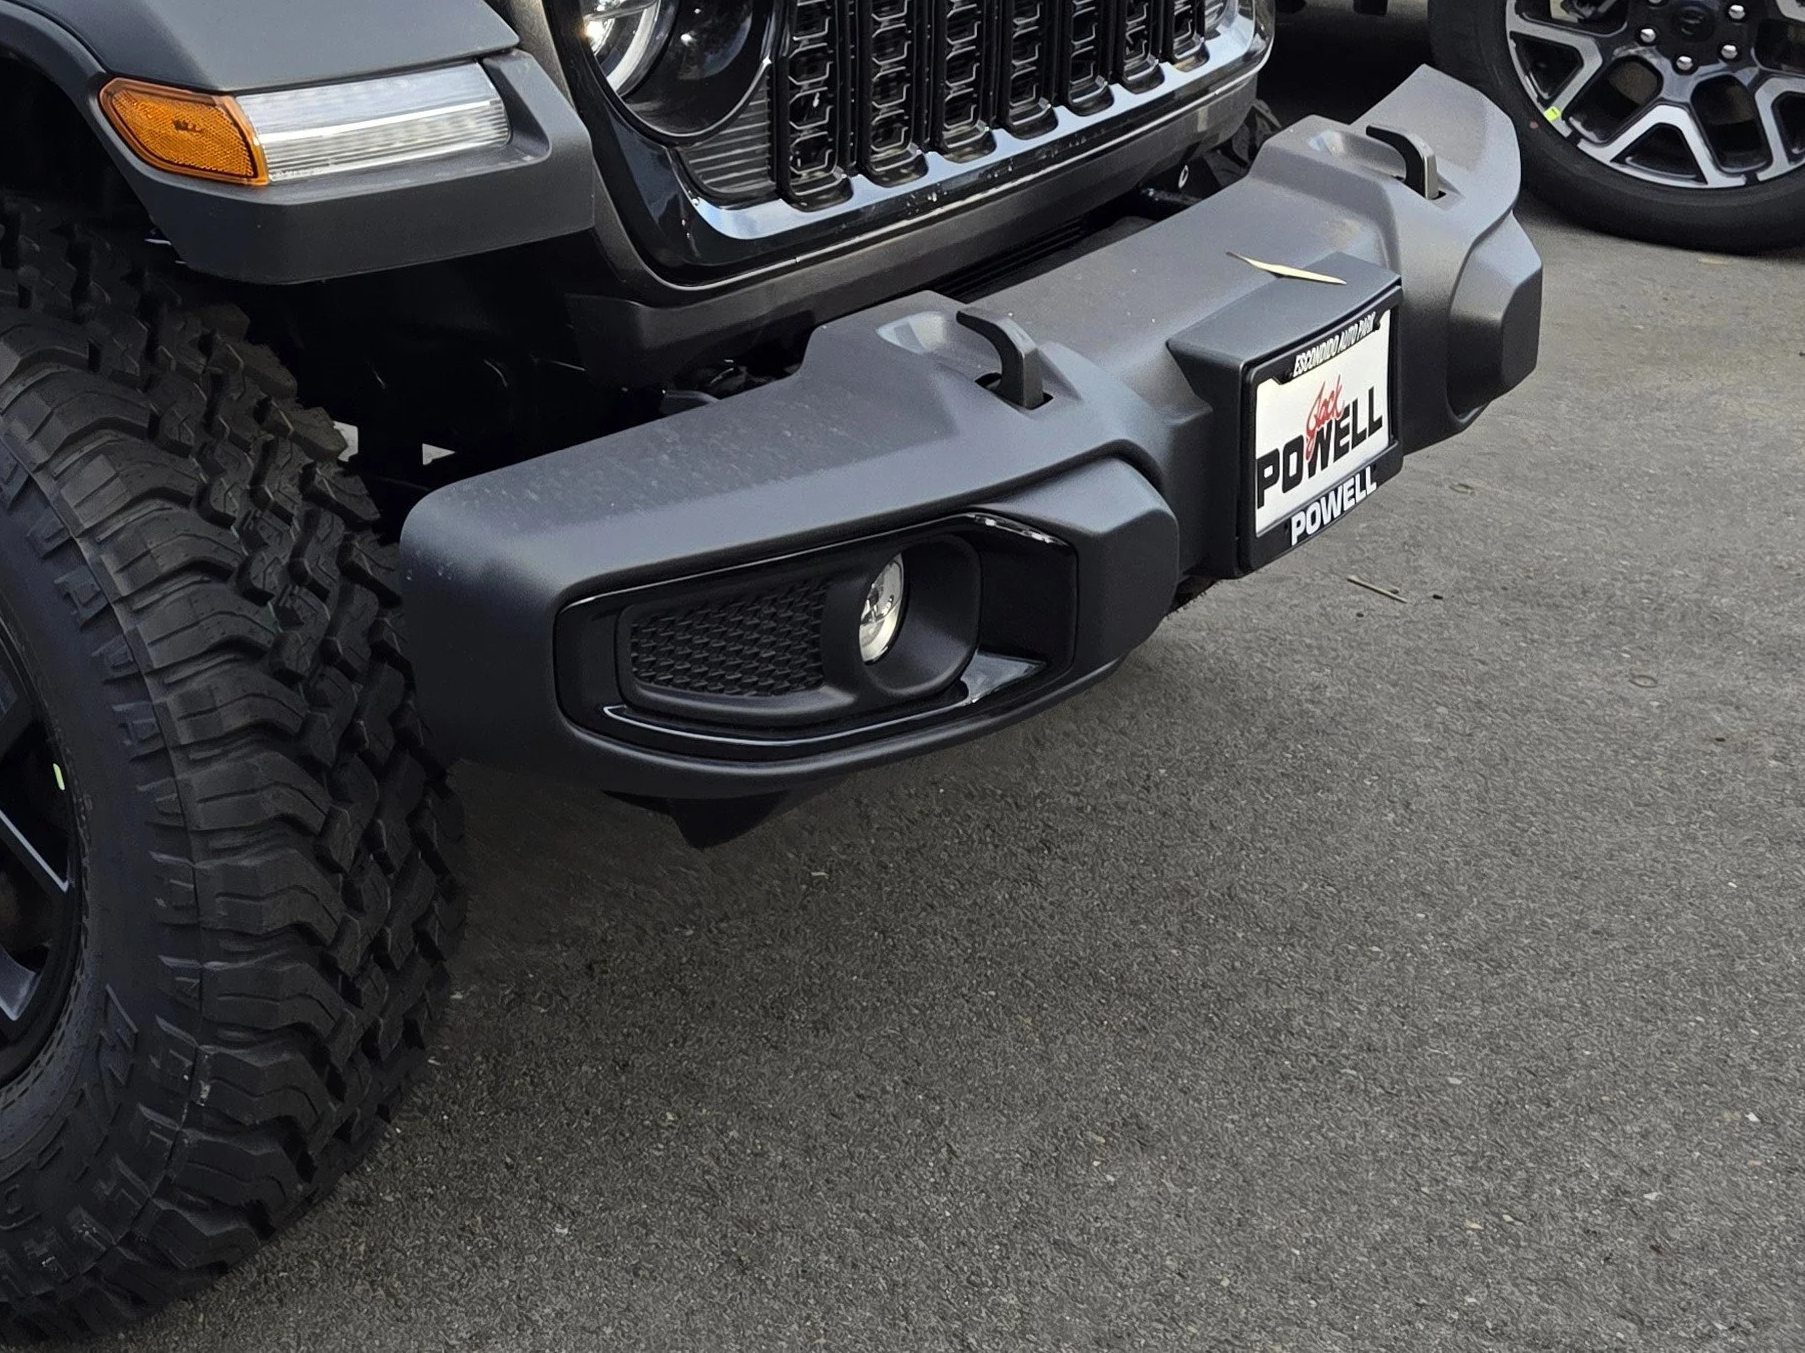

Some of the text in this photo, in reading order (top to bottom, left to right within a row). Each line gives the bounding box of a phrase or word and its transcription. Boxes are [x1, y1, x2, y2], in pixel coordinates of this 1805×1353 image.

[1293, 333, 1340, 378] ESCONDIDO
[1257, 386, 1383, 509] POWELL
[1306, 374, 1345, 461] Jack
[1291, 466, 1377, 547] POWELL
